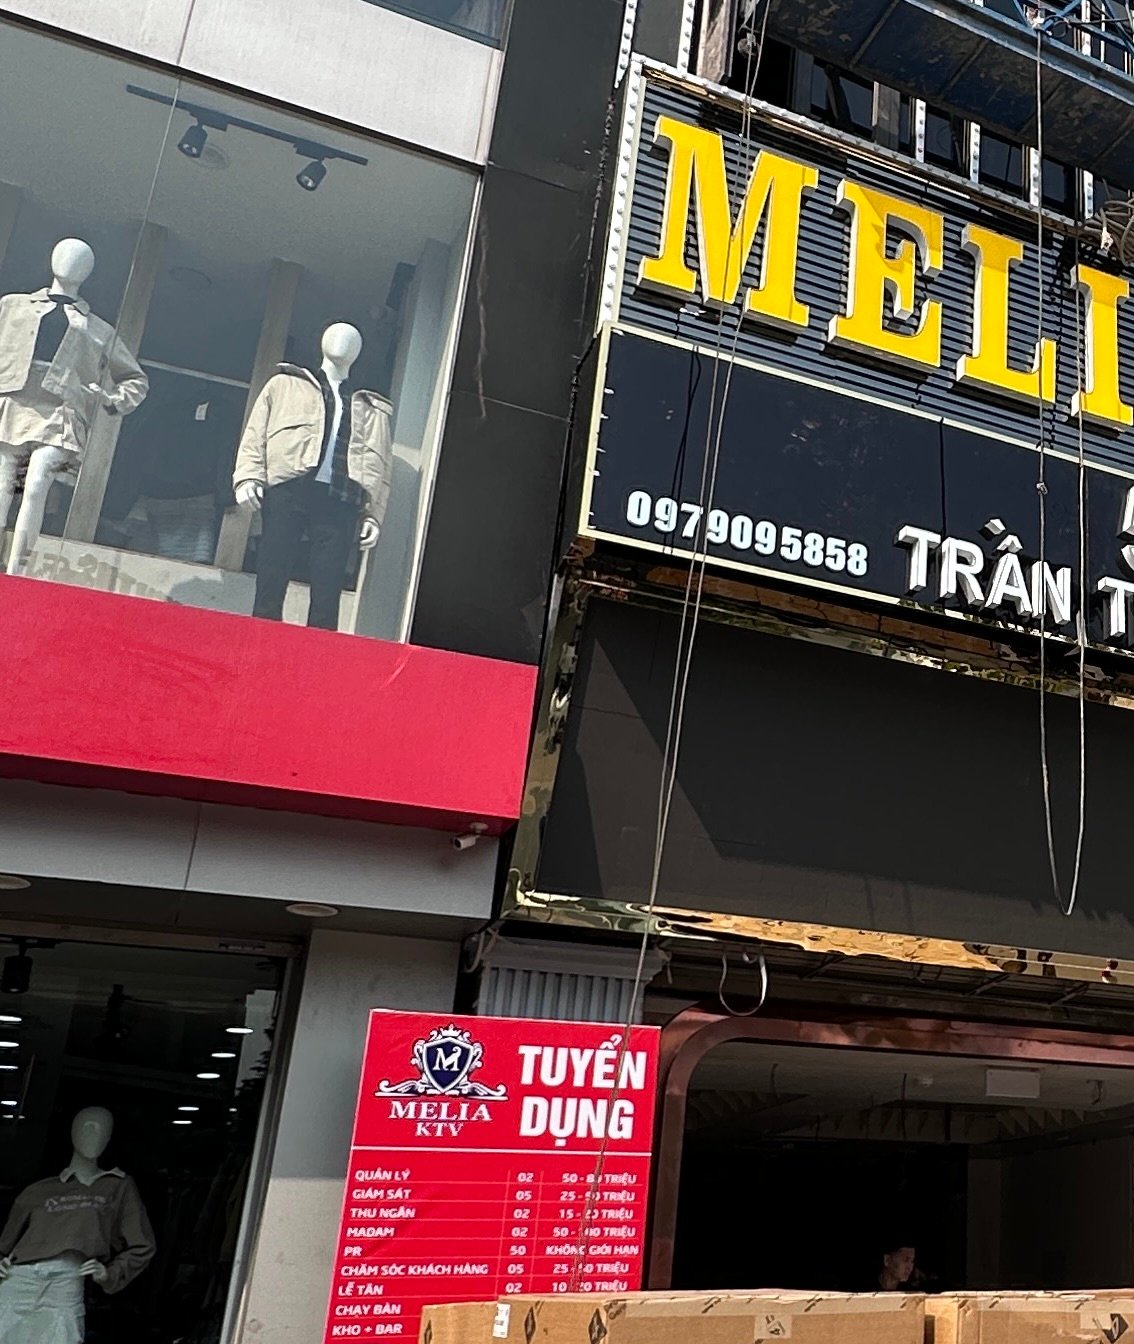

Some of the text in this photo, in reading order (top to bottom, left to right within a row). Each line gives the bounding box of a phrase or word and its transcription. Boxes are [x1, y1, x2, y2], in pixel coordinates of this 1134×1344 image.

[625, 489, 869, 578] 0979095858
[893, 518, 1073, 627] TRẦN
[518, 1033, 648, 1090] TUYỂN
[388, 1100, 493, 1121] MELIA
[519, 1096, 635, 1147] DỤNG
[415, 1122, 464, 1138] KTV
[517, 1172, 534, 1183] 02
[562, 1172, 578, 1183] 50
[604, 1172, 637, 1185] TRIỆU
[352, 1188, 385, 1200] GIÁM
[386, 1188, 411, 1200] SÁT
[515, 1190, 532, 1201] 05
[560, 1191, 576, 1201] 25
[602, 1190, 635, 1203] TRIỆU
[350, 1208, 377, 1218] THU
[379, 1206, 416, 1219] NGÂN
[513, 1209, 530, 1219] 02
[559, 1209, 574, 1219] 15
[601, 1208, 634, 1221] TRIỆU
[346, 1227, 395, 1238] MADAM
[511, 1227, 528, 1237] 02
[552, 1227, 569, 1237] 50
[603, 1227, 636, 1239] TRIỆU
[344, 1246, 362, 1257] PR
[510, 1245, 526, 1256] 50
[341, 1264, 378, 1276] CHĂM
[381, 1263, 406, 1275] SÓC
[408, 1263, 451, 1274] KHÁCH
[454, 1263, 489, 1274] HÀNG
[507, 1264, 524, 1274] 05
[553, 1264, 569, 1274] 25
[596, 1262, 630, 1274] TRIỆU
[357, 1284, 384, 1296] TÂN
[505, 1283, 522, 1293] 02
[552, 1282, 567, 1292] 10
[594, 1281, 628, 1294] TRIỆU
[332, 1325, 361, 1336] KHO
[375, 1323, 403, 1335] BAR
